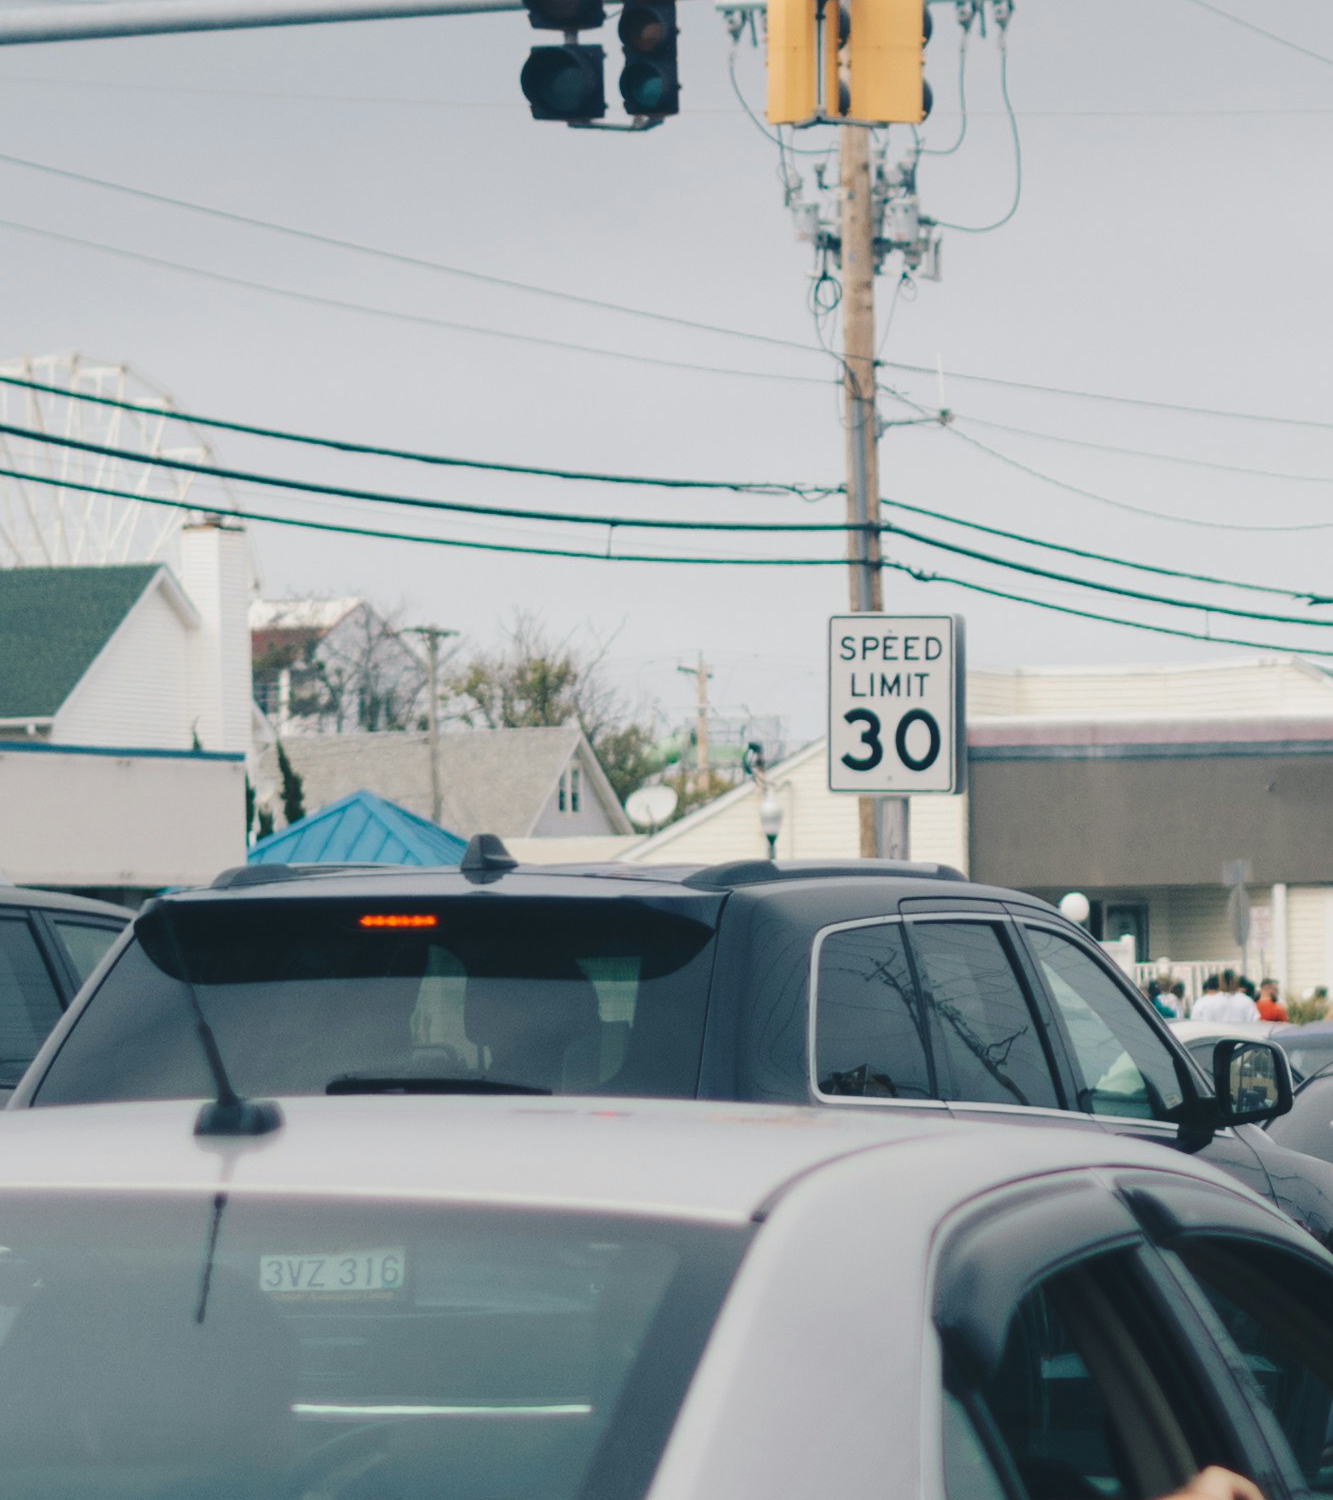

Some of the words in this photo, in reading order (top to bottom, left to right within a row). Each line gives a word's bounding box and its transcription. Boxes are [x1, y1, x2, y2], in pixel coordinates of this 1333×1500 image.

[840, 636, 943, 661] SPEED
[851, 672, 930, 697] LIMIT
[841, 707, 941, 772] 30
[265, 1260, 327, 1287] 3VZ
[338, 1255, 400, 1286] 316
